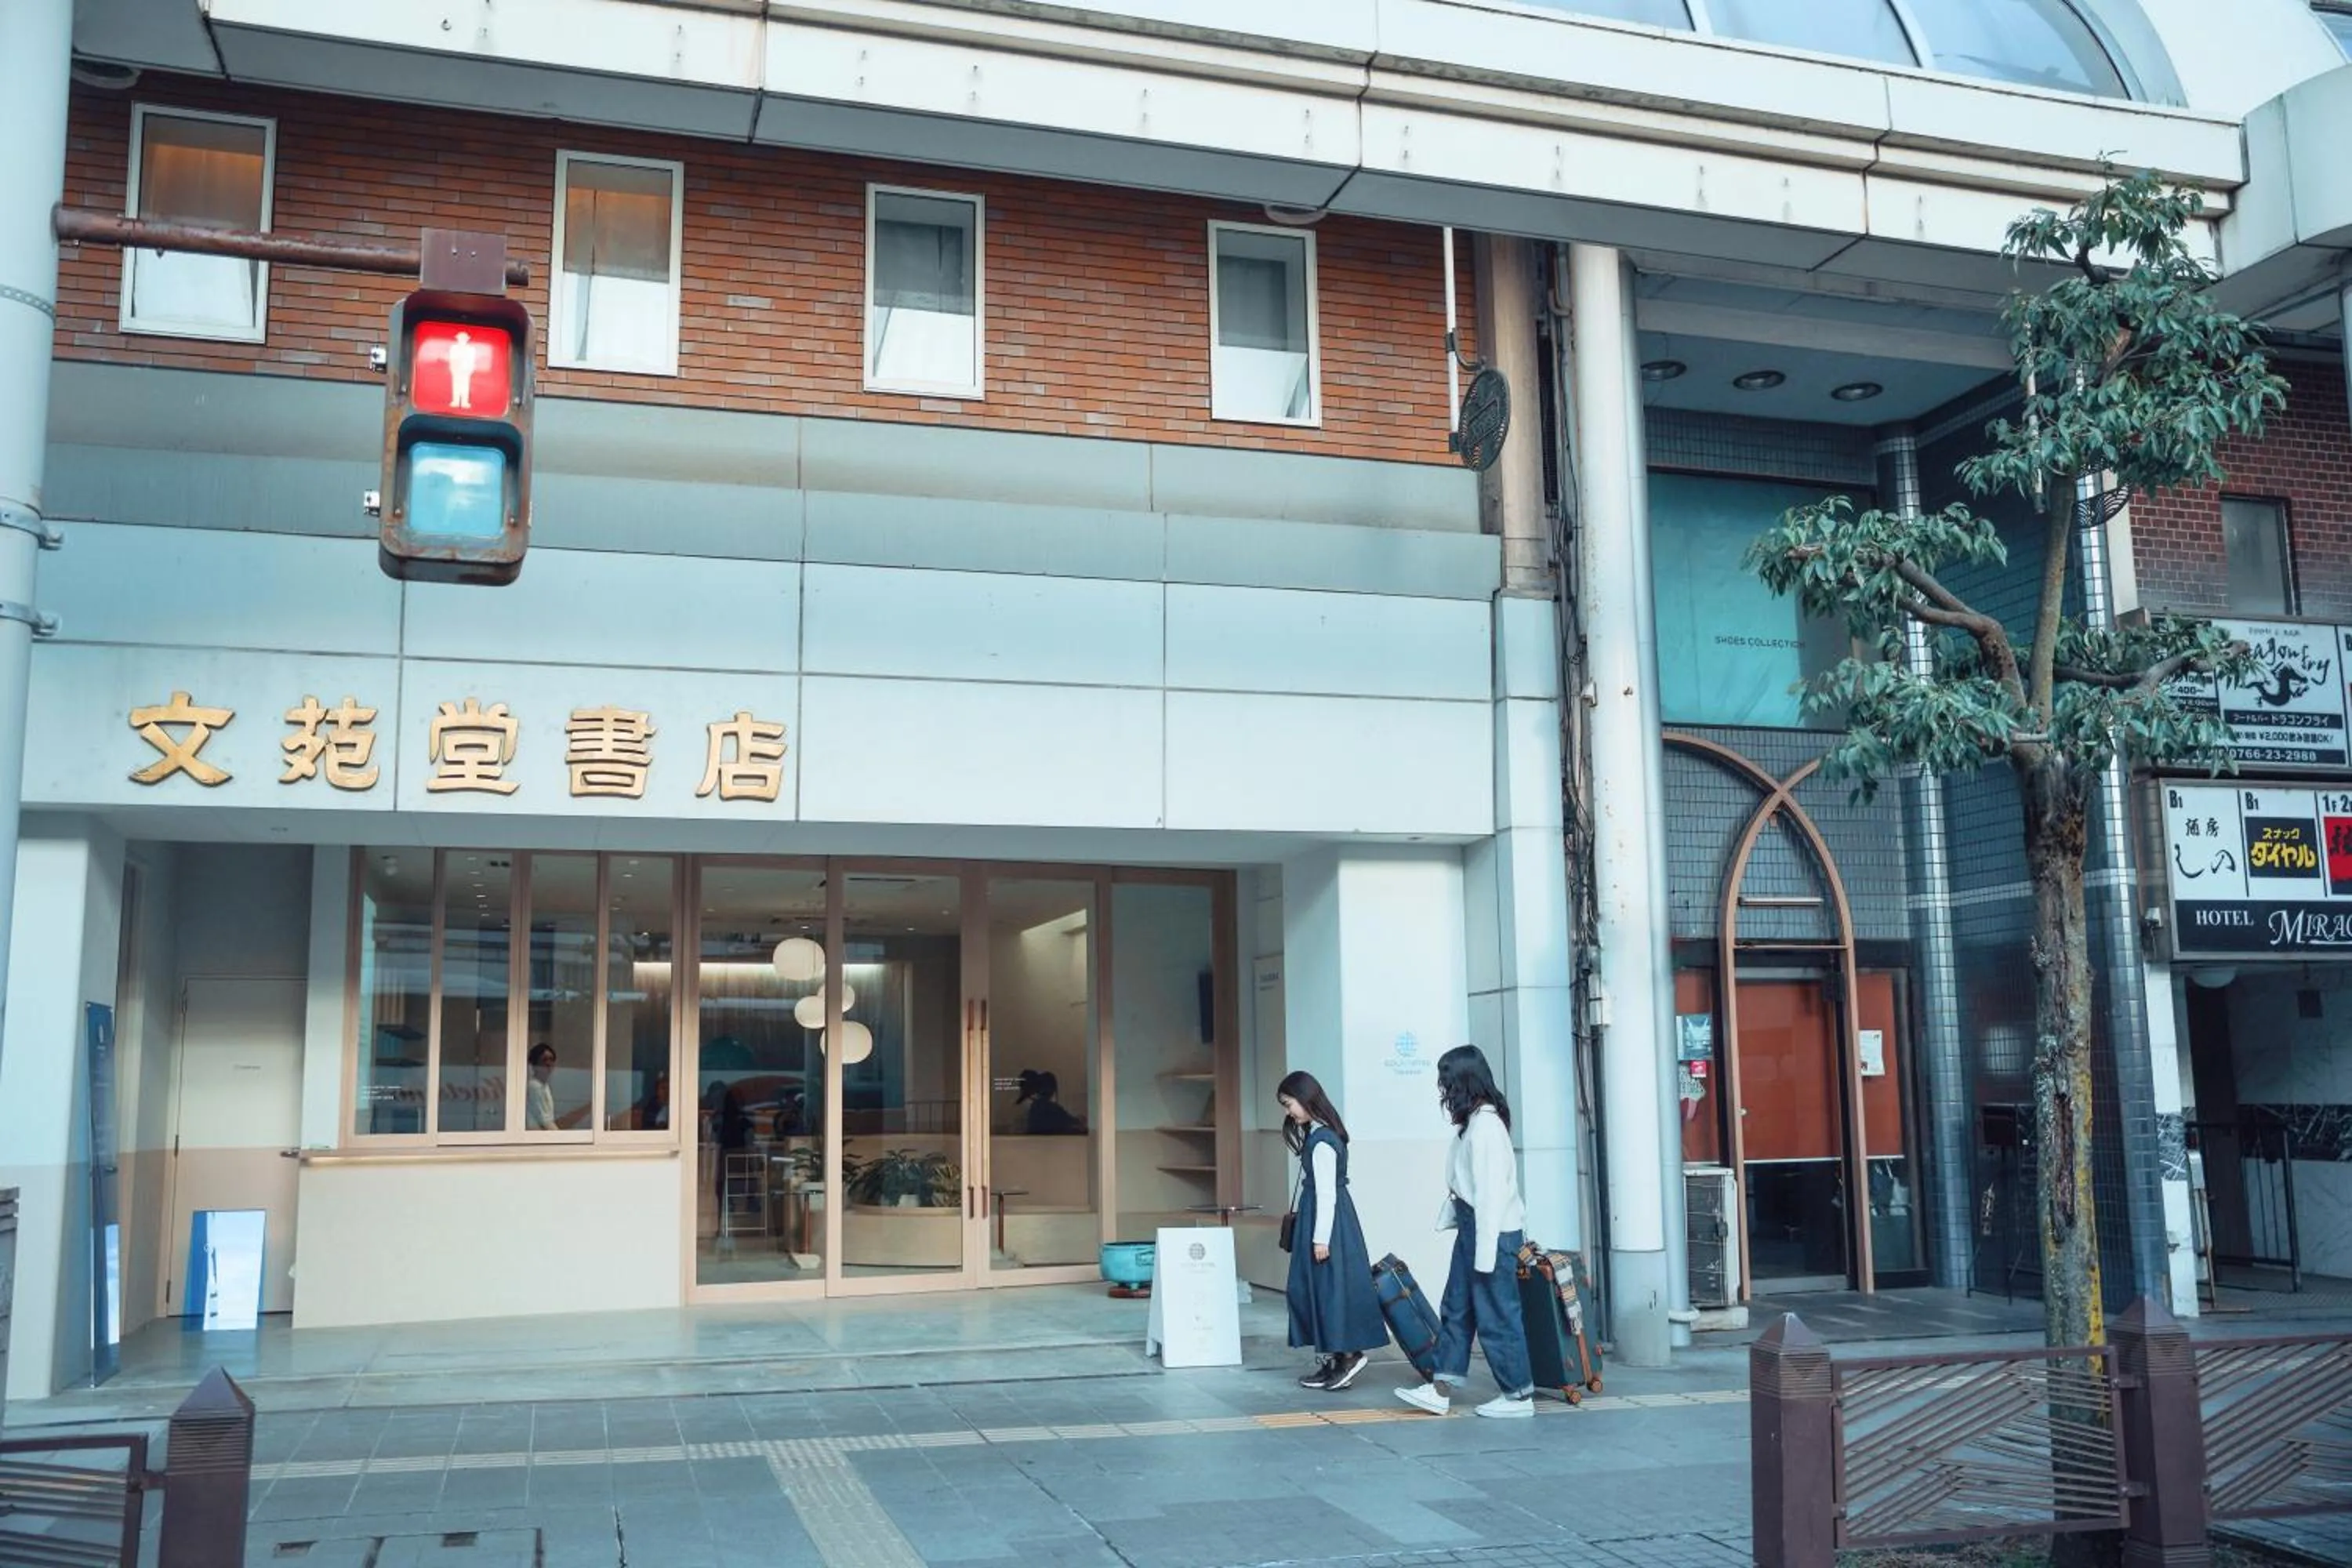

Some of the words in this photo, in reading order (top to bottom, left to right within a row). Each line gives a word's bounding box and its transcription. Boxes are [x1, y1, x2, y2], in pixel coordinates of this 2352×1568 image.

[1715, 635, 1746, 646] SHOES
[1748, 637, 1806, 649] COLLECTION
[128, 690, 788, 801] 文苑堂書店
[2169, 789, 2183, 808] B1
[2245, 793, 2259, 811] B1
[2262, 827, 2301, 840] スナック
[2250, 841, 2317, 869] ダイヤル
[2195, 909, 2255, 926] HOTEL
